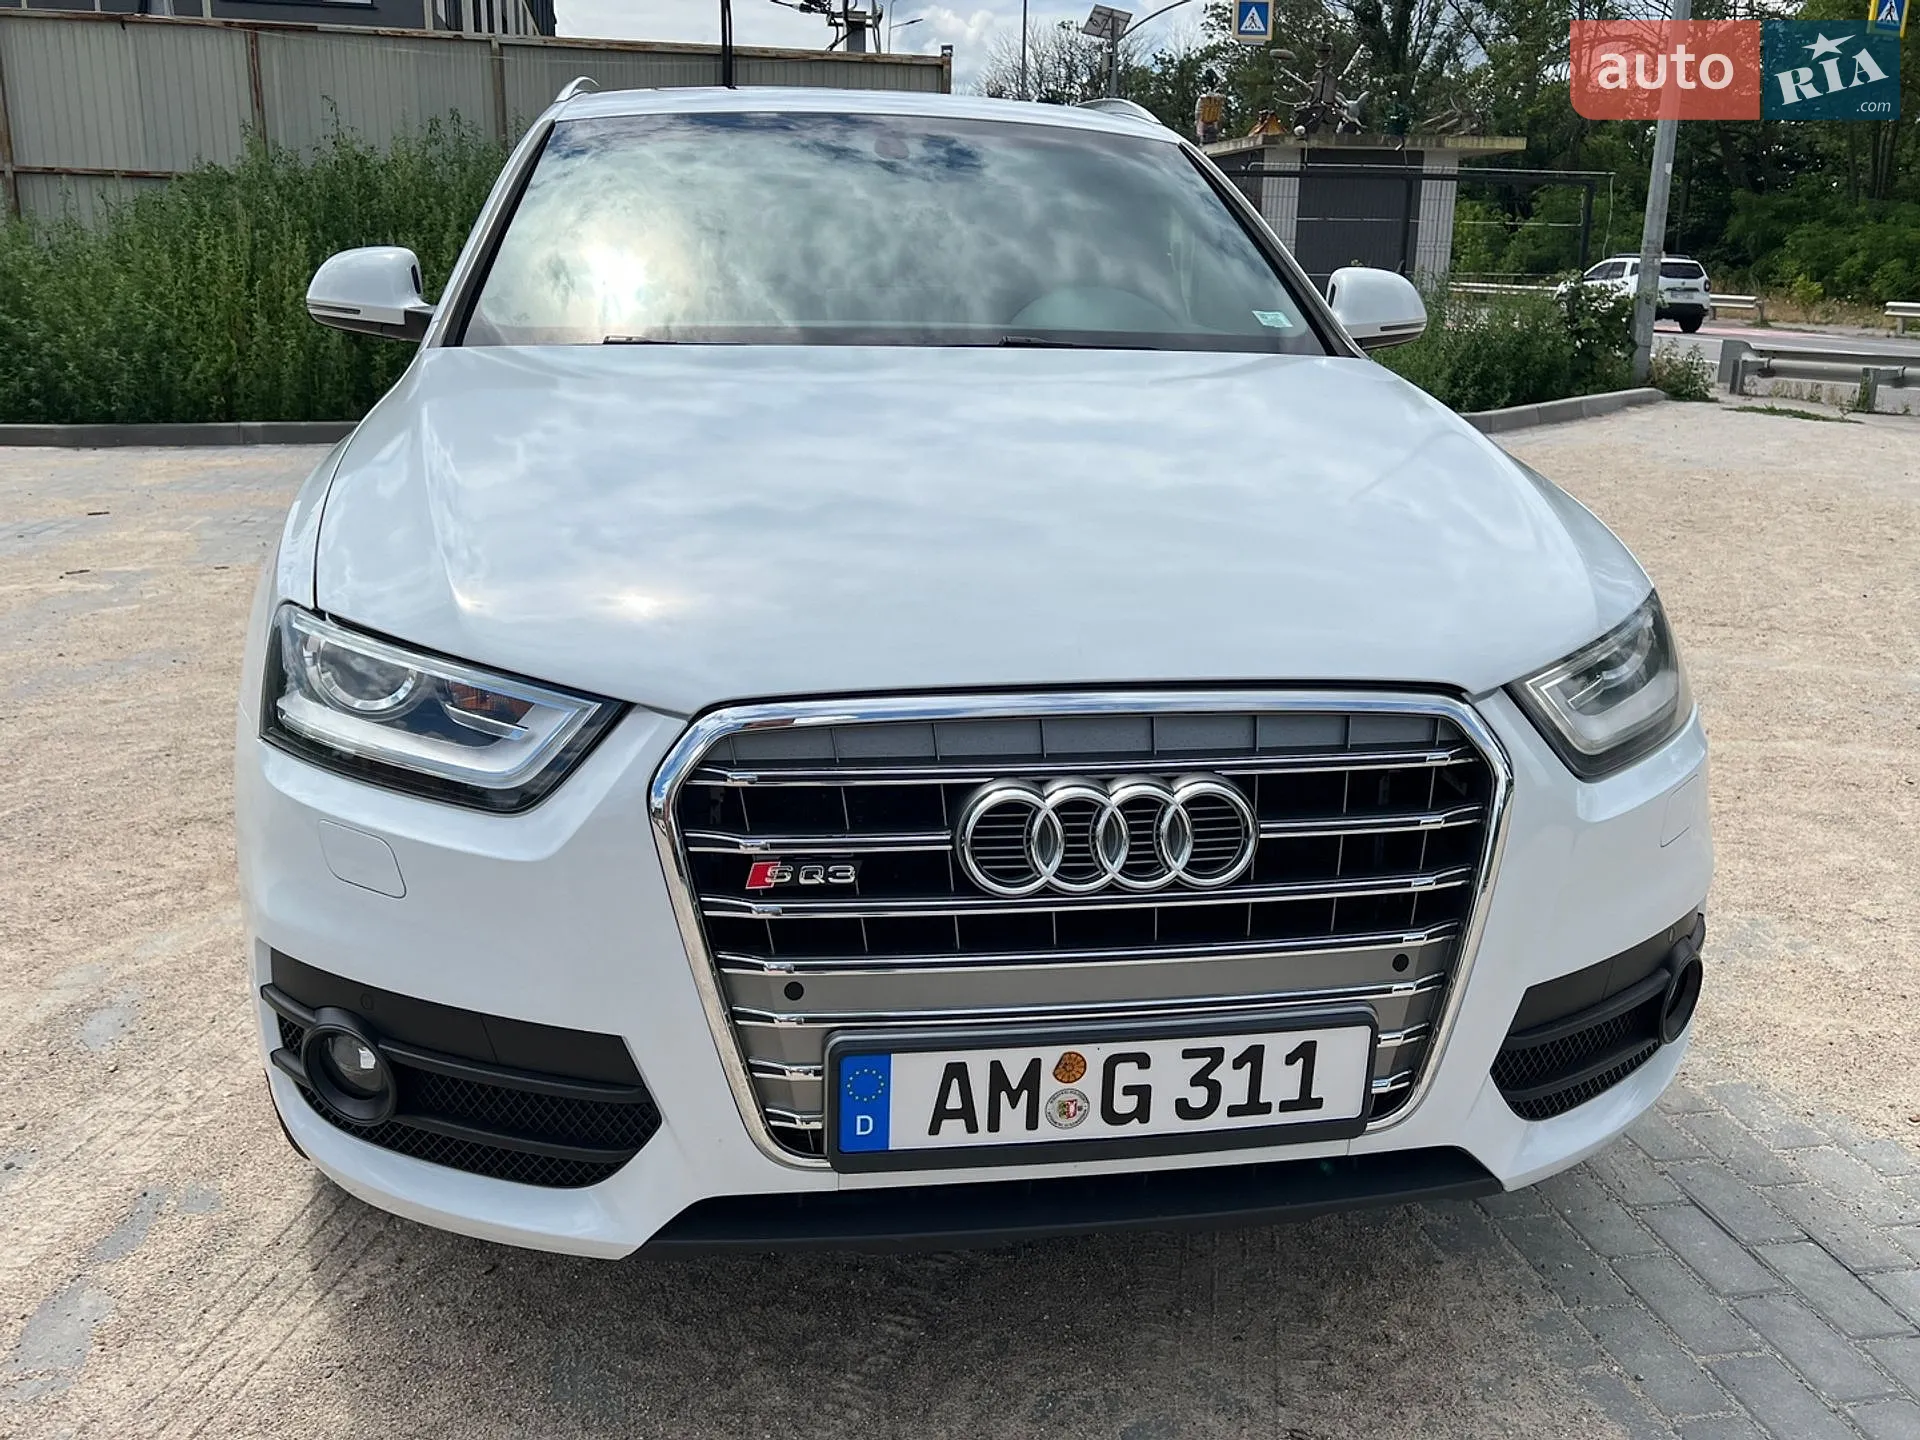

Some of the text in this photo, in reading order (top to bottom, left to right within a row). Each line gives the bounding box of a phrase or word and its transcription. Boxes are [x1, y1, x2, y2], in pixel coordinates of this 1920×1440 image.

[764, 865, 856, 885] SQ3
[928, 1057, 1042, 1136] AM
[1101, 1051, 1152, 1126] G
[1174, 1039, 1324, 1121] 311
[855, 1115, 874, 1136] D
